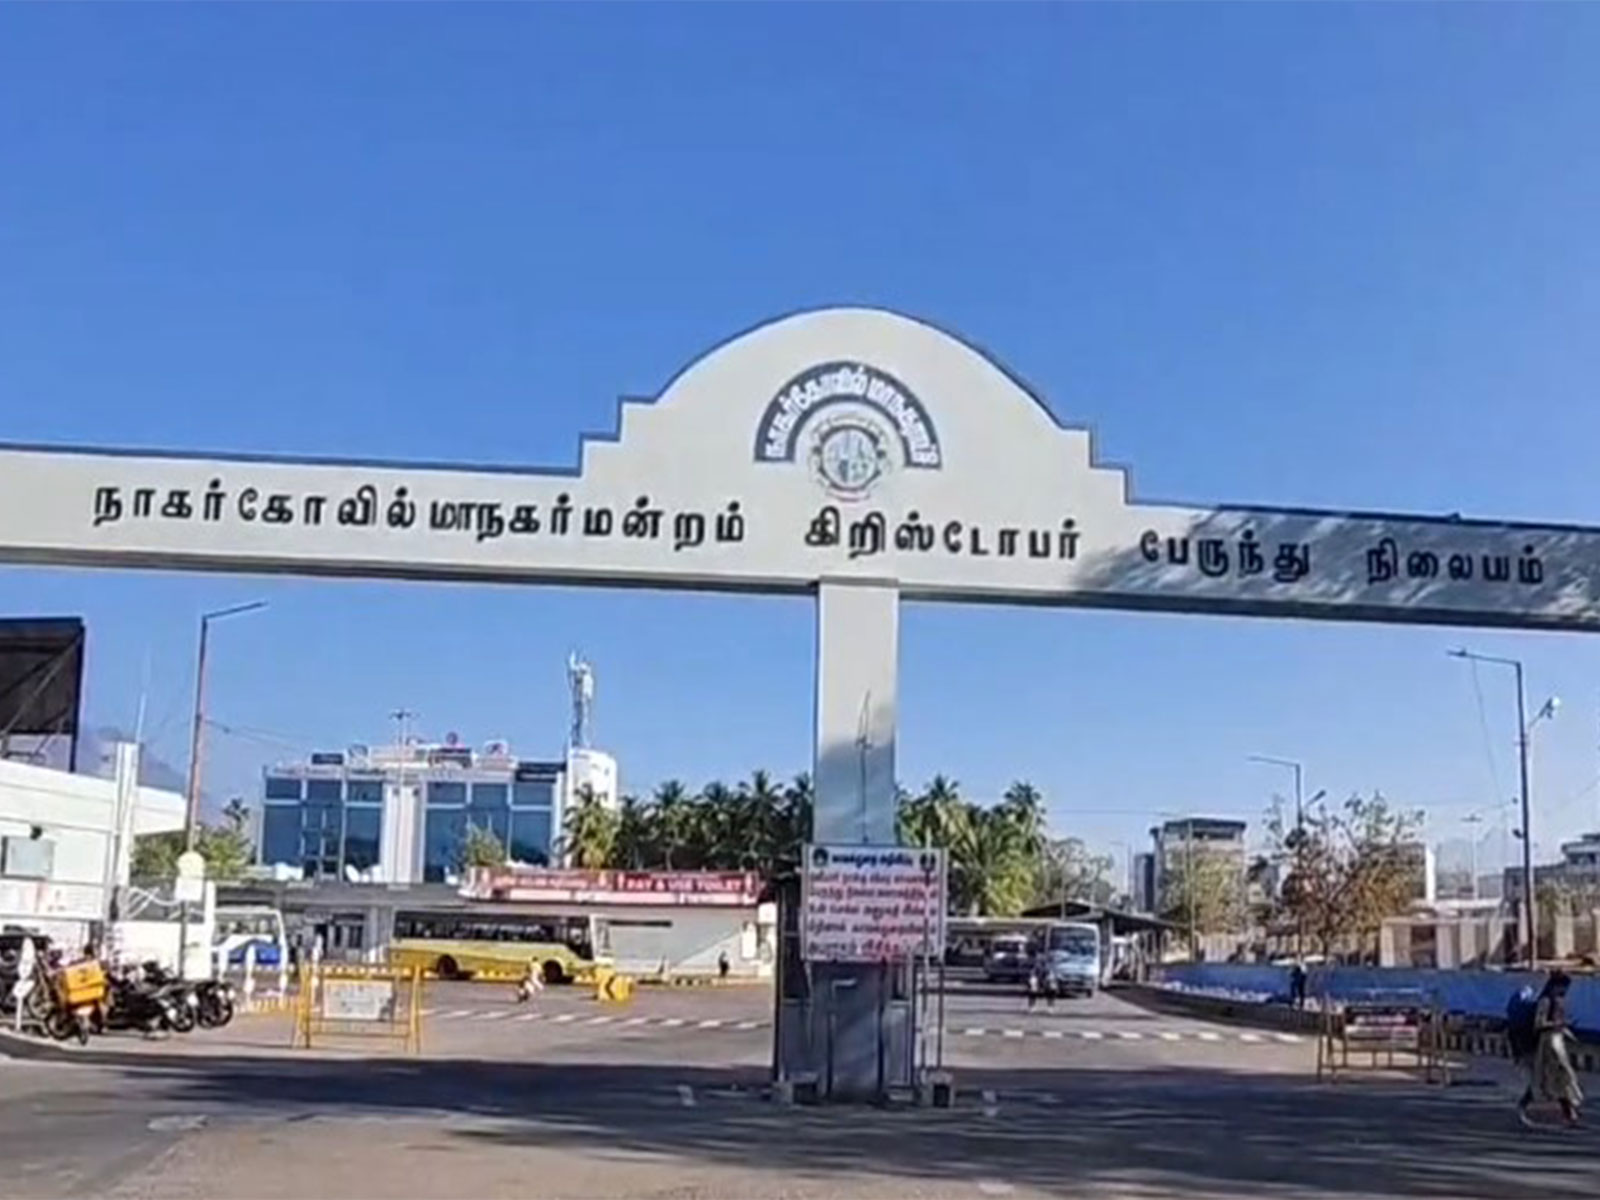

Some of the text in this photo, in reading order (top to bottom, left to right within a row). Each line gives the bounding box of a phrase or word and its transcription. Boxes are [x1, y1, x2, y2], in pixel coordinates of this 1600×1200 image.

[804, 505, 1081, 560] கிறிஸ்டோபர்
[1140, 526, 1310, 583] பேருந்து
[1366, 537, 1545, 586] நிலையம்
